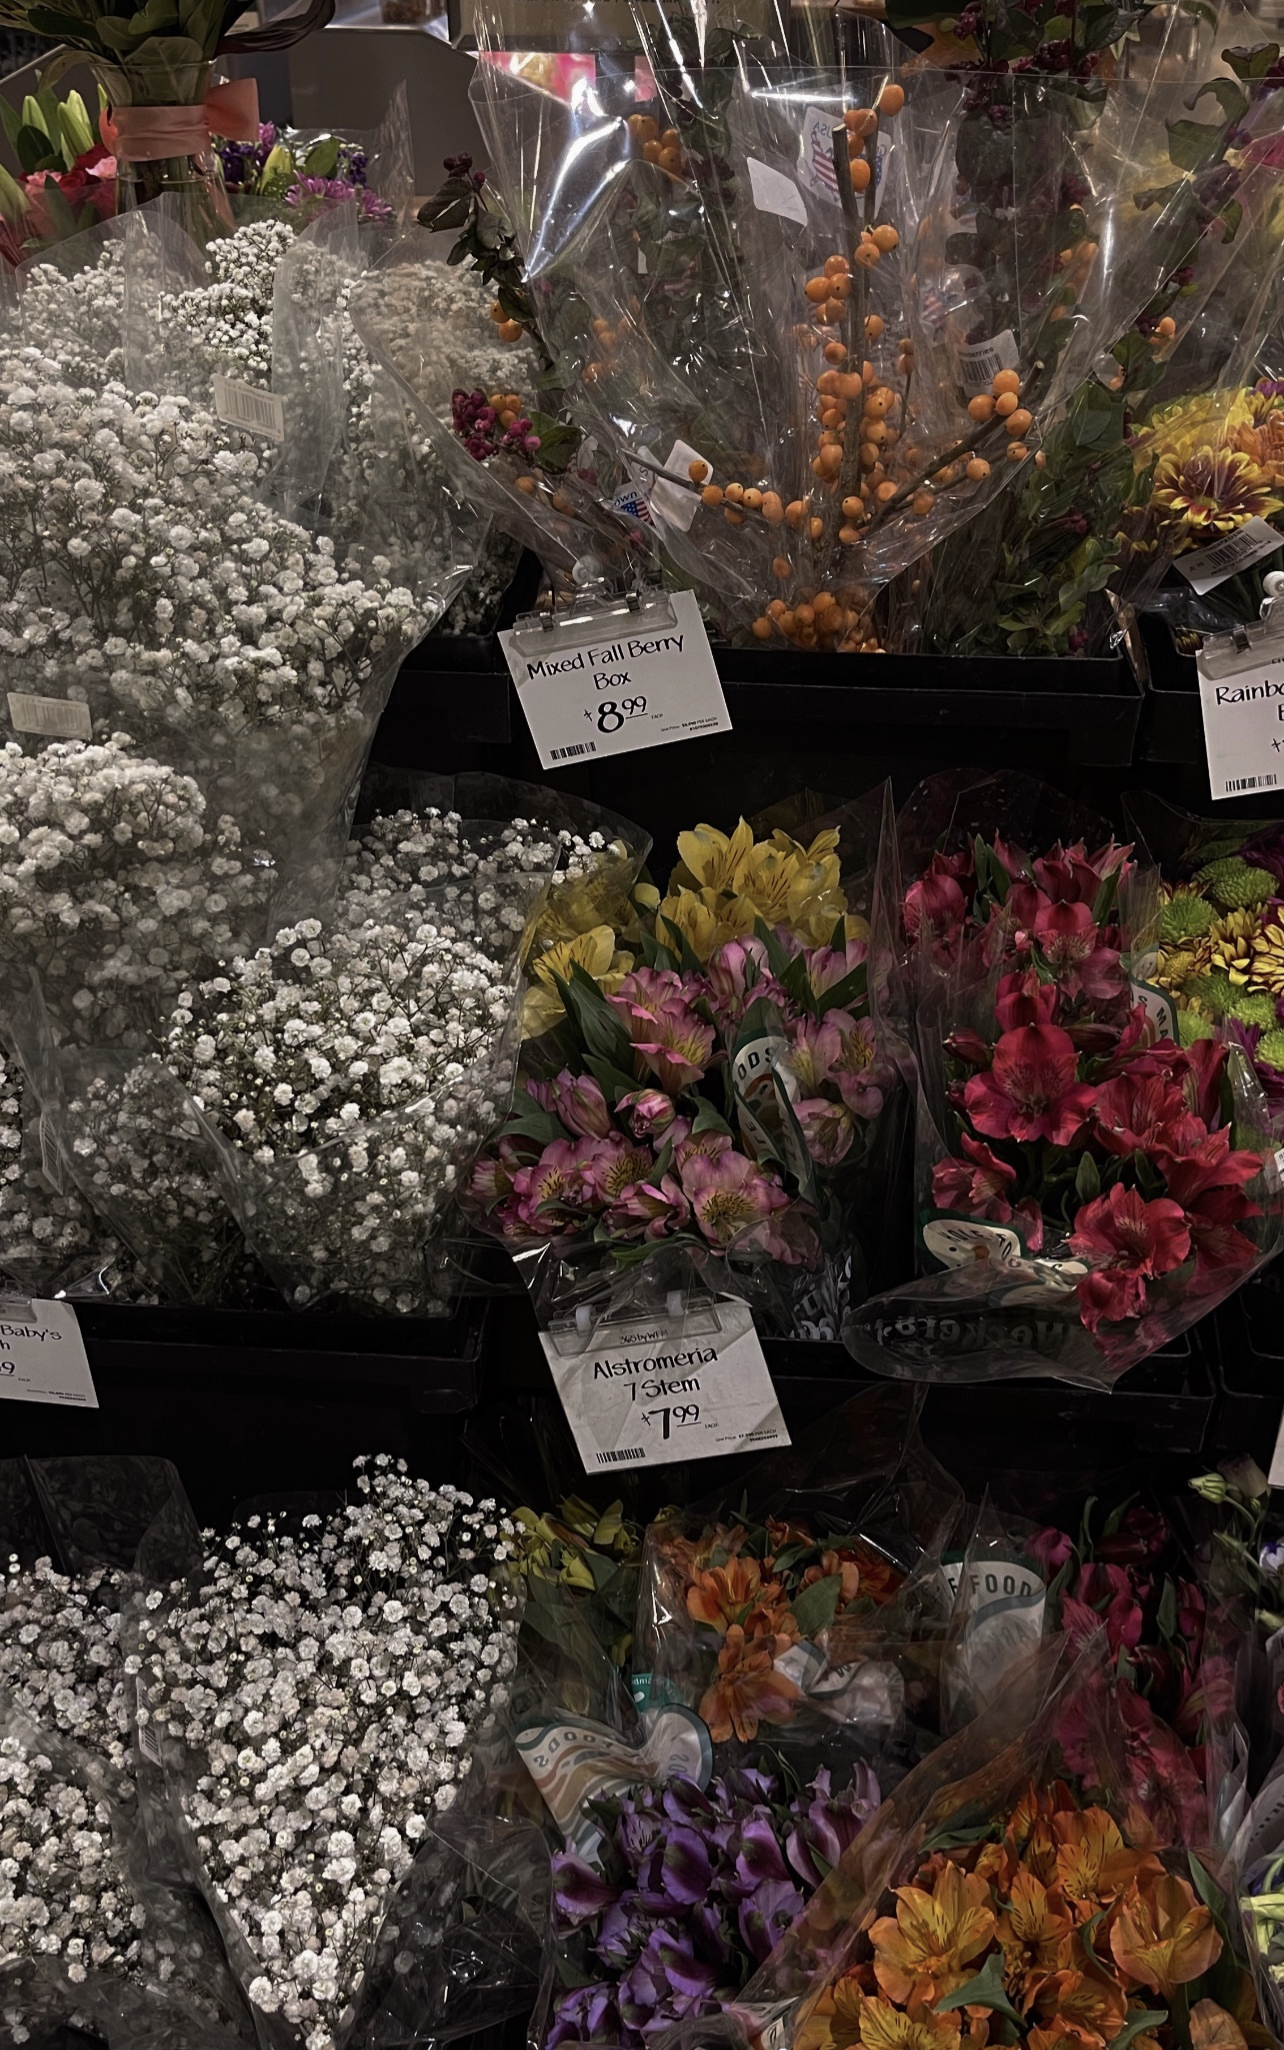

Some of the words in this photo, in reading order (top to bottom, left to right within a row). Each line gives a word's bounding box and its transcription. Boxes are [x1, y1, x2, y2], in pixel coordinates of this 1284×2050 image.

[527, 653, 585, 680] Mixed
[587, 644, 625, 666] Fall
[627, 635, 684, 659] Berry
[593, 672, 632, 690] Box
[0, 1324, 62, 1341] Baby's
[594, 1346, 718, 1379] Alstromeria
[624, 1382, 637, 1401] 7
[641, 1377, 700, 1398] Stem
